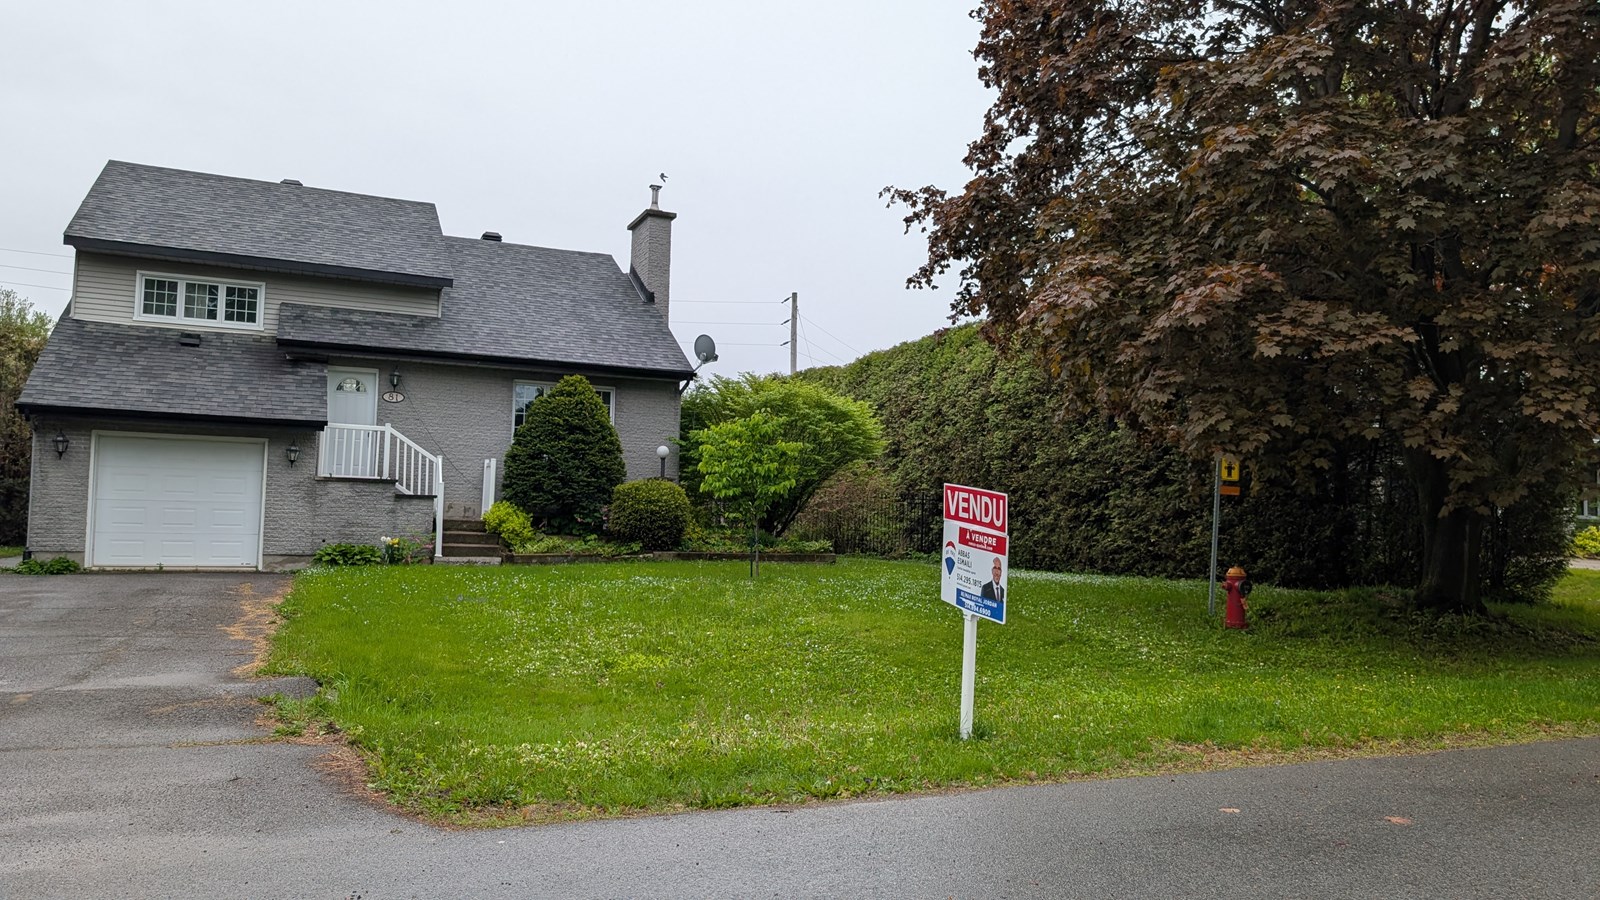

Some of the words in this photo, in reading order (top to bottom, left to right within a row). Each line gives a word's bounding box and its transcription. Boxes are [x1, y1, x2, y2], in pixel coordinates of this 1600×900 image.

[388, 392, 398, 402] 81
[947, 489, 1004, 528] VENDU
[971, 532, 997, 546] VENDRE
[958, 549, 970, 559] ABBAS
